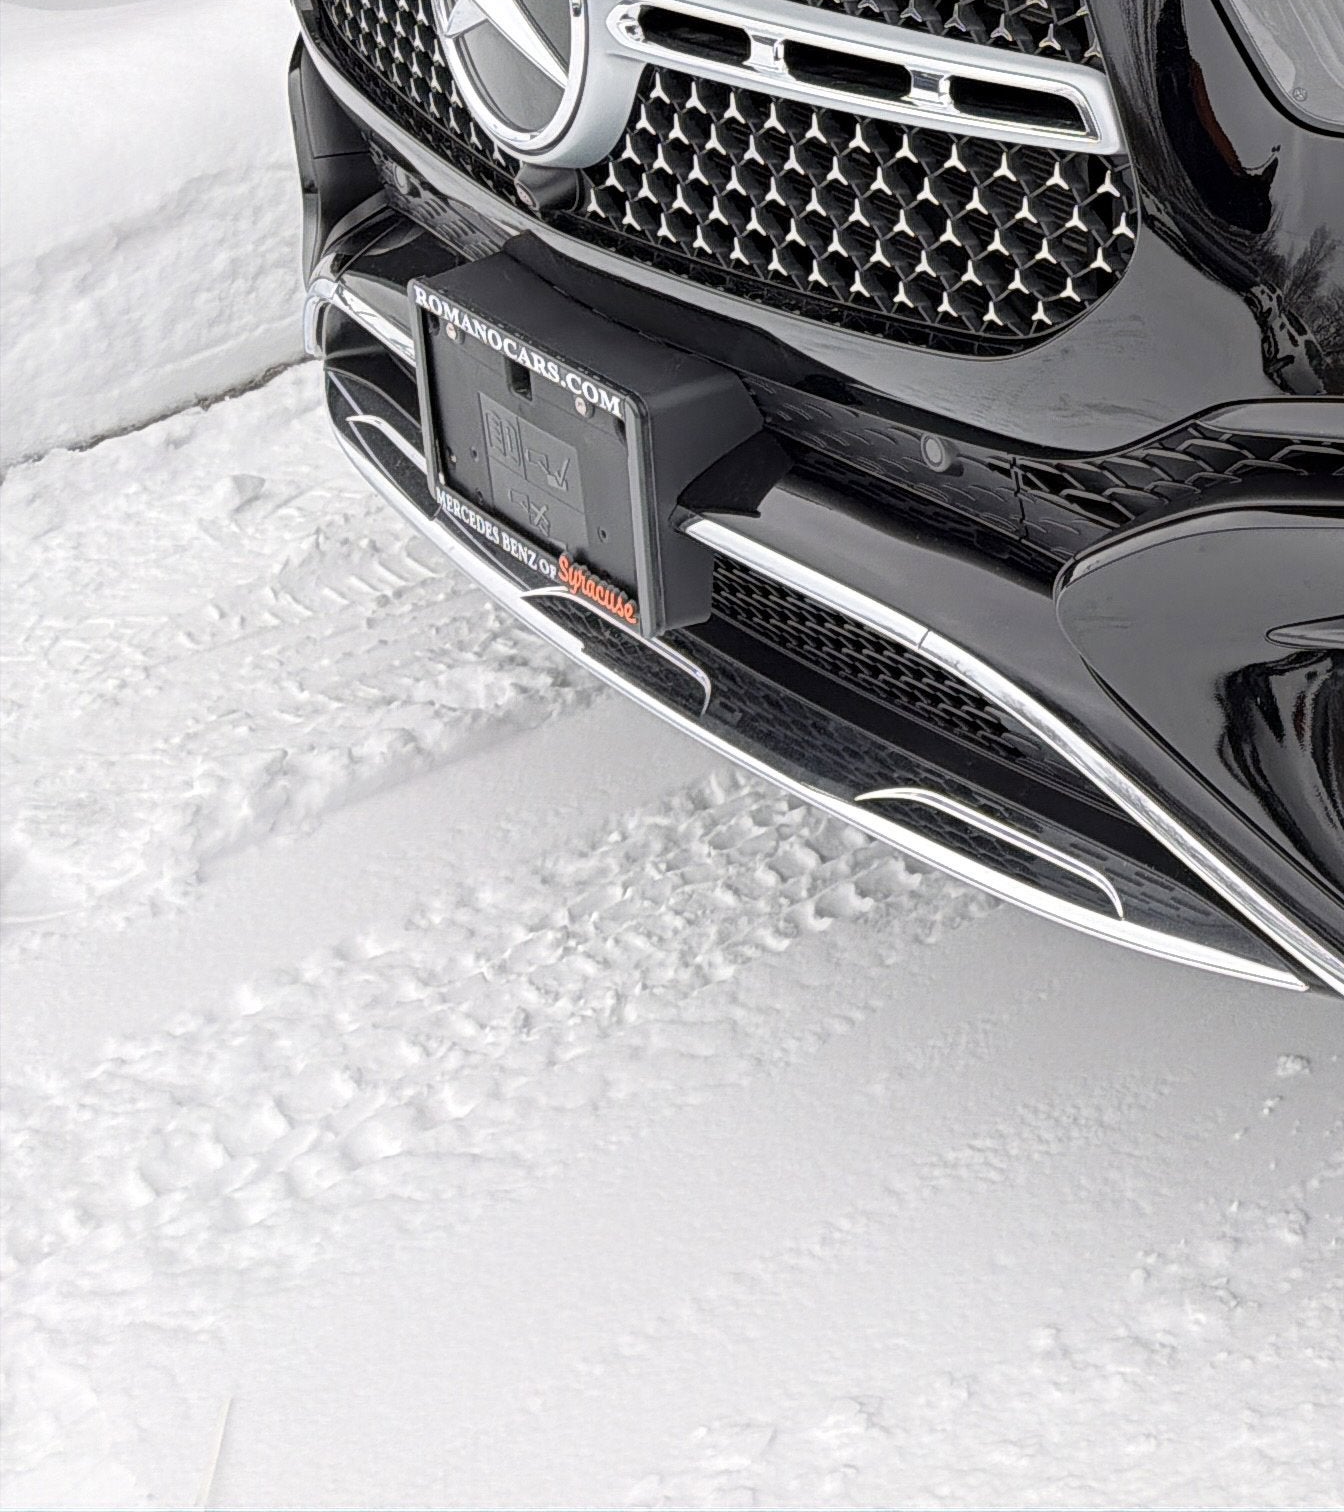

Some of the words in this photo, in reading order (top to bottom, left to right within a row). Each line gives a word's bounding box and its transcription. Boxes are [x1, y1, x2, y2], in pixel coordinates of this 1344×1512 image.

[413, 284, 625, 418] ROMANOCARS.COM
[435, 485, 500, 546] MERCEDES
[501, 531, 538, 572] BENZ
[557, 553, 640, 626] Syracuse
